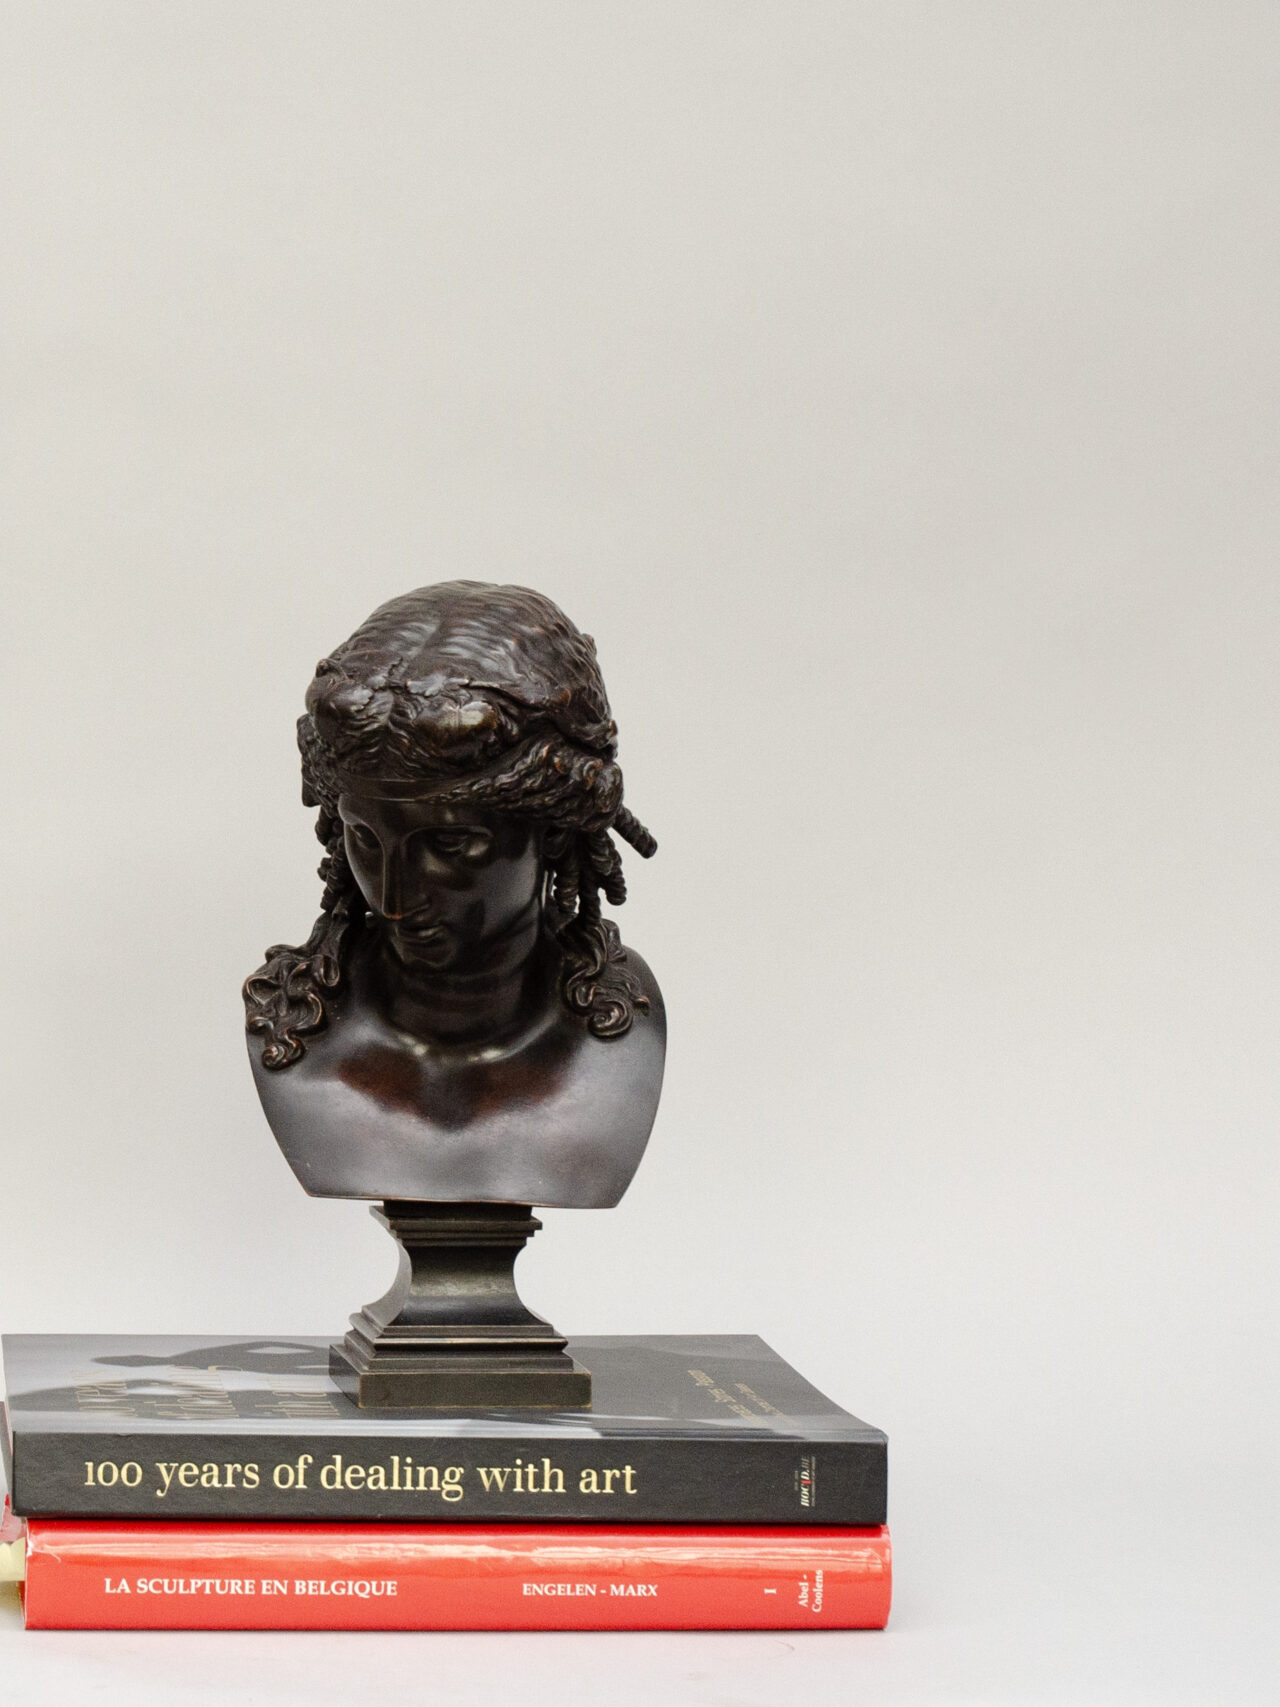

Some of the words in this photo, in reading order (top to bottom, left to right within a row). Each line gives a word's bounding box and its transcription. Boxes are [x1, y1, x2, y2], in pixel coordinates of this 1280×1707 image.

[83, 1460, 144, 1488] 100
[155, 1462, 260, 1498] years
[272, 1454, 313, 1490] of
[320, 1455, 465, 1502] dealing
[476, 1457, 565, 1494] with
[578, 1465, 637, 1495] art
[104, 1577, 131, 1594] LA
[136, 1577, 255, 1595] SCULPTURE
[260, 1579, 288, 1596] EN
[294, 1579, 398, 1599] BELGIQUE
[522, 1583, 597, 1596] ENGELEN
[609, 1583, 658, 1597] MARX
[798, 1582, 809, 1607] Abel
[811, 1569, 823, 1612] Coolens
